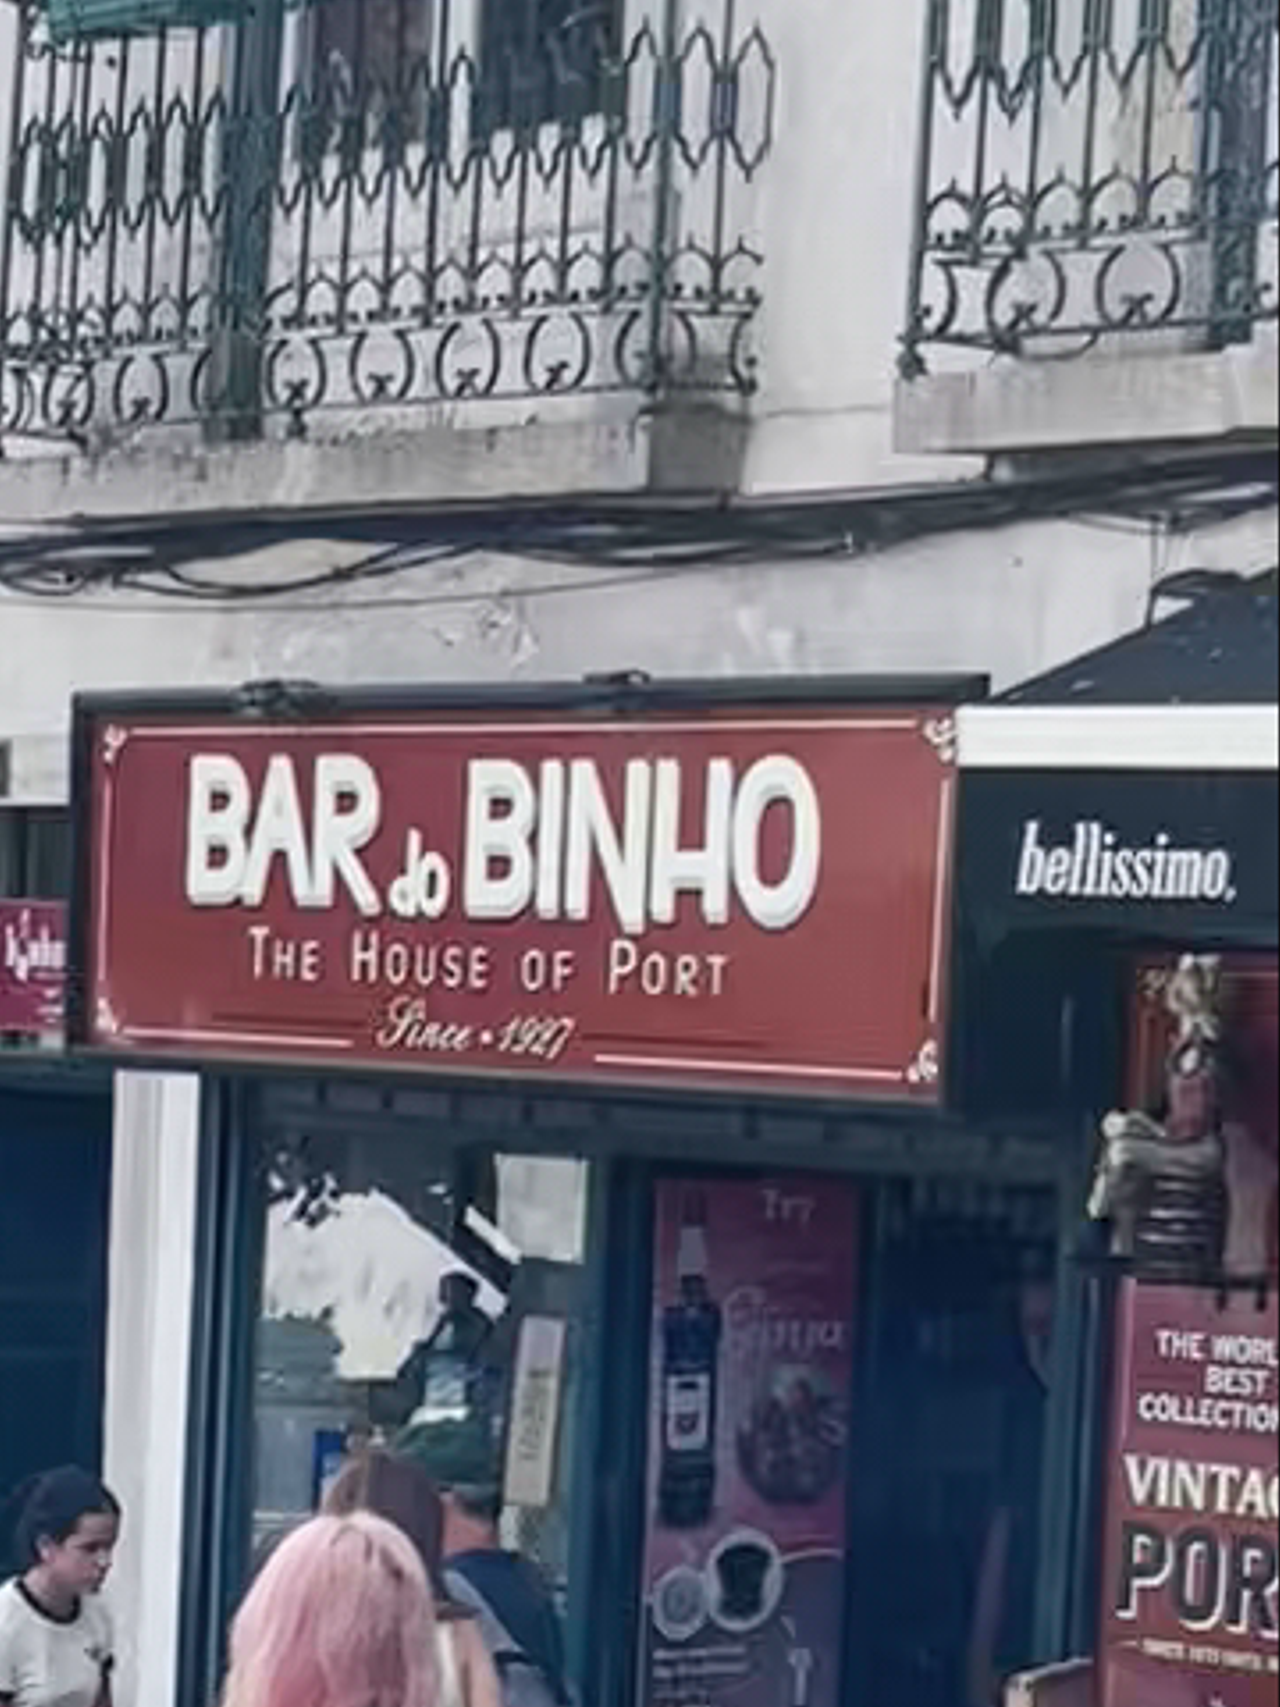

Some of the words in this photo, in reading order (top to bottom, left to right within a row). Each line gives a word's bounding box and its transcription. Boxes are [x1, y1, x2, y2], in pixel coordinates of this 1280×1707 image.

[186, 753, 382, 917] BAR
[388, 826, 451, 918] do
[464, 755, 821, 934] BINHO
[1015, 819, 1238, 903] bellissimo.
[609, 938, 729, 997] PORT
[376, 995, 473, 1051] Since
[1154, 1329, 1208, 1360] THE
[1204, 1363, 1270, 1395] BEST
